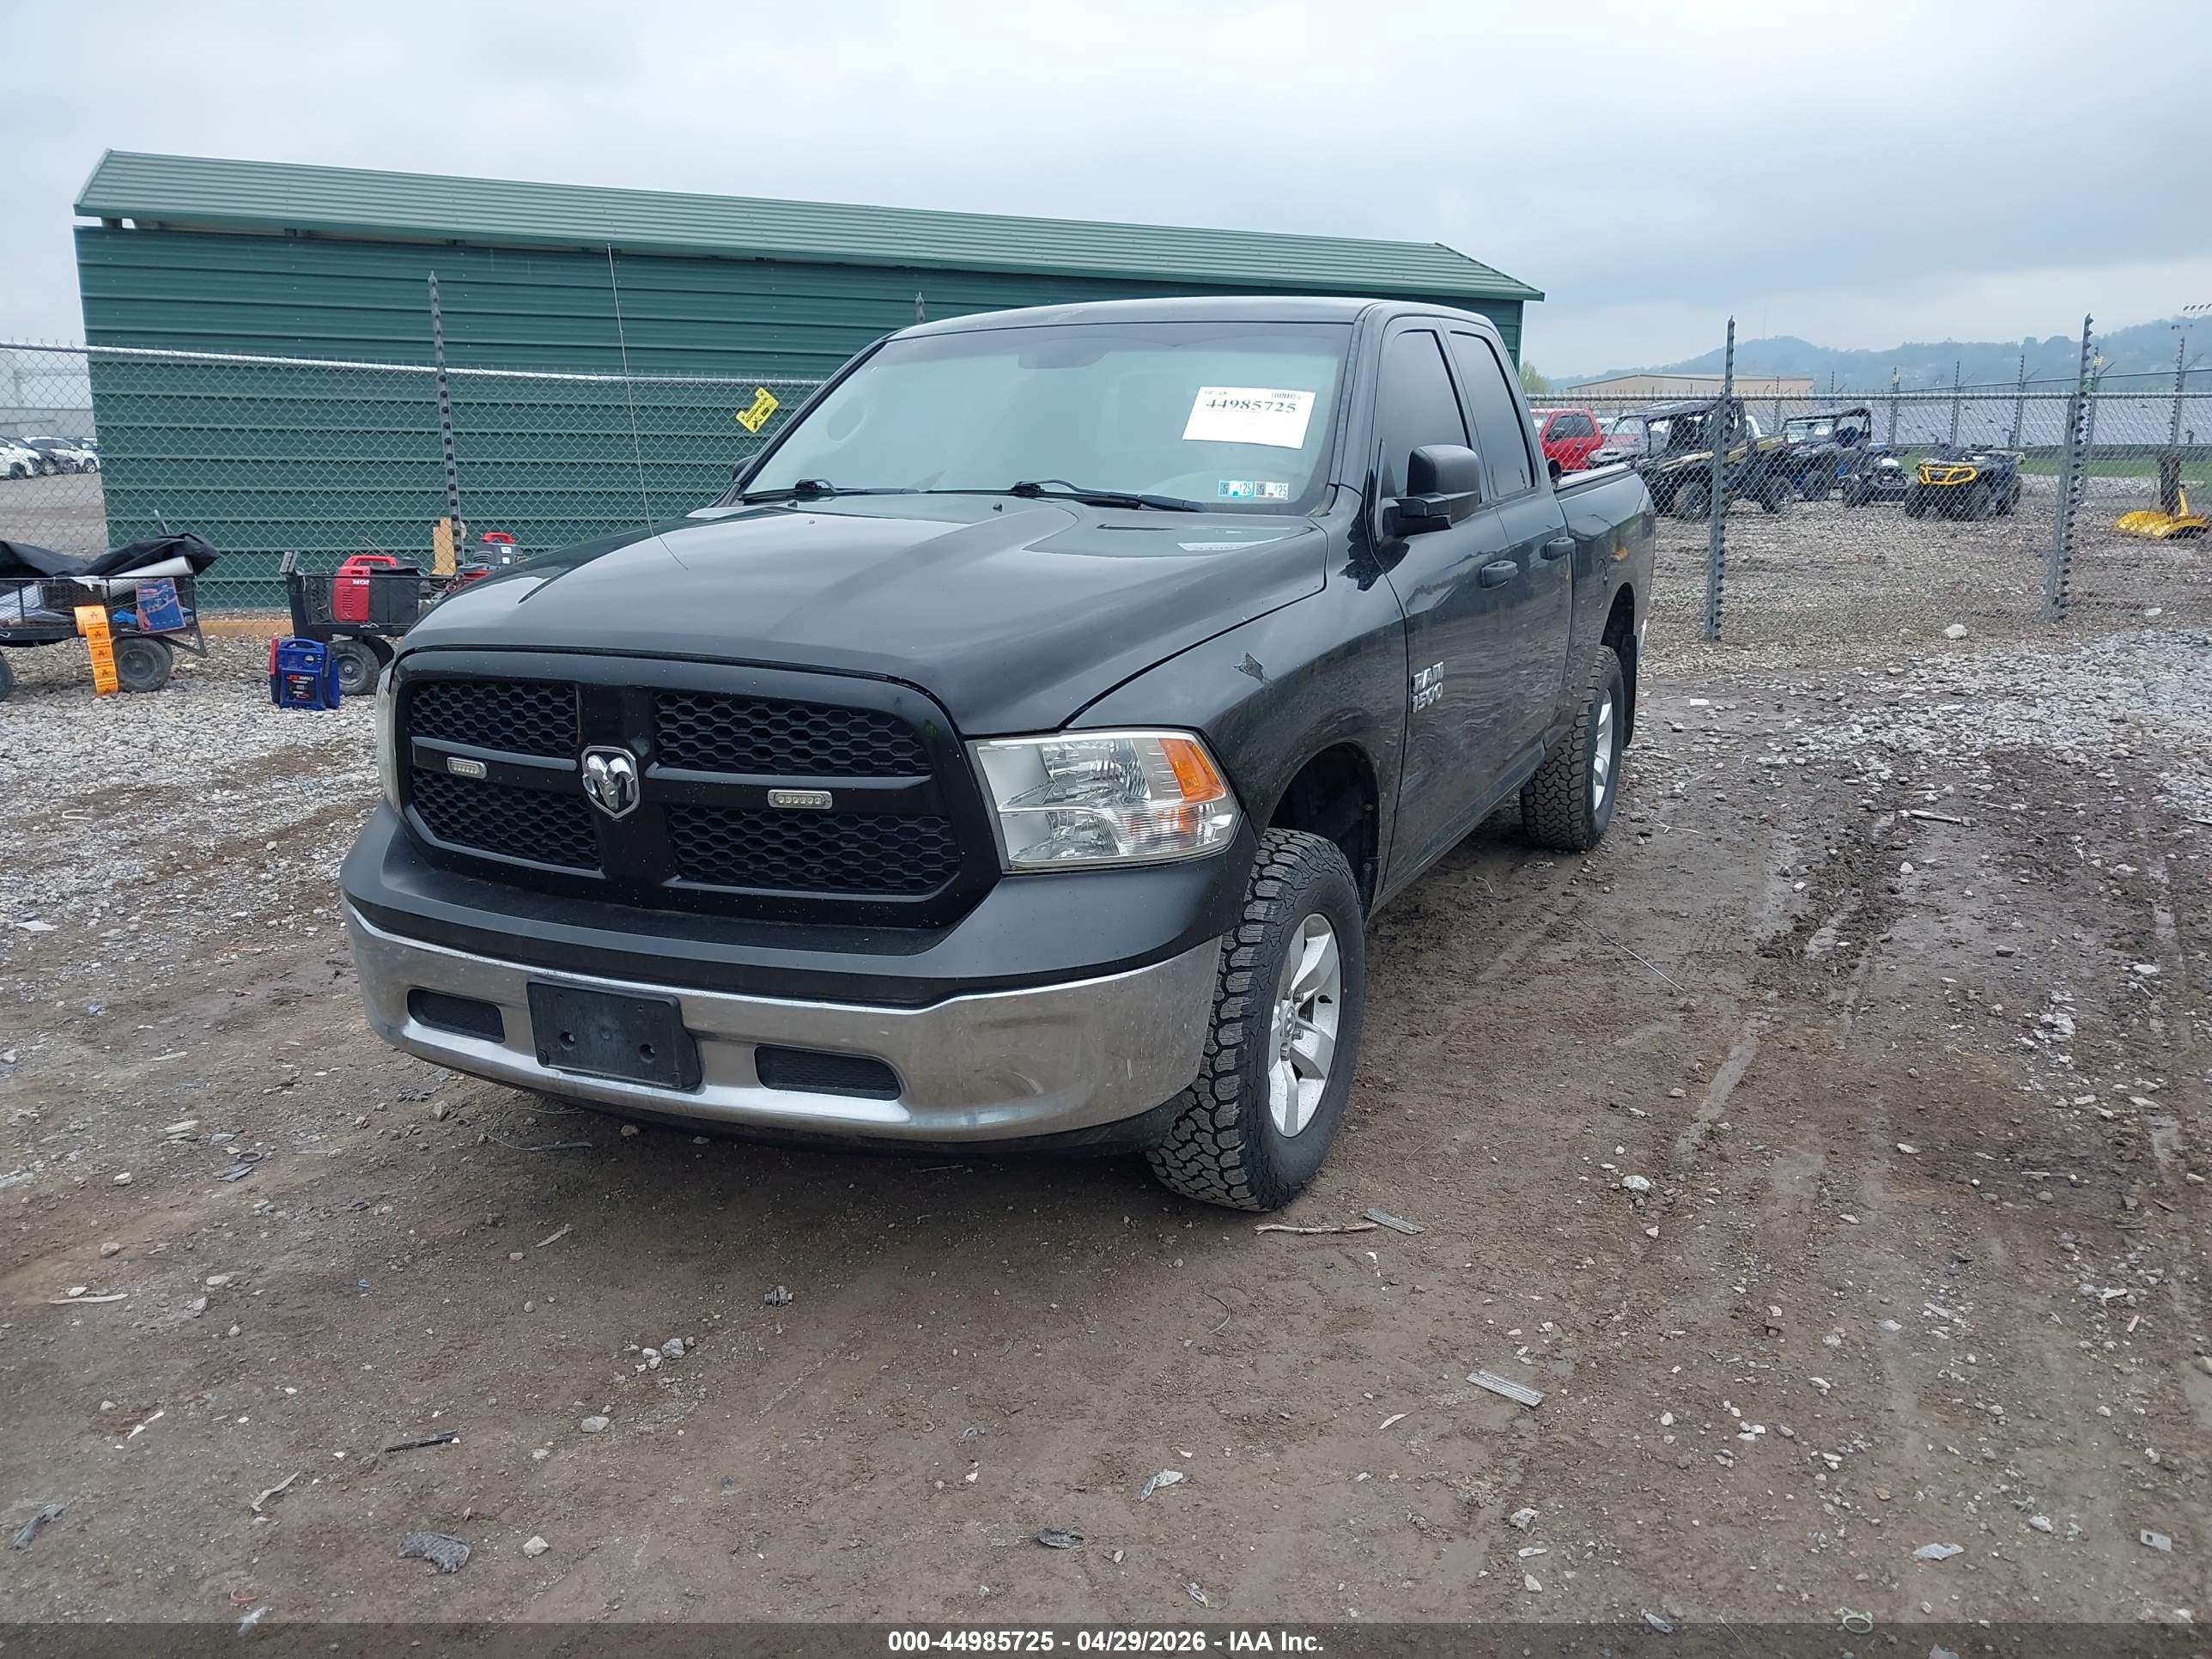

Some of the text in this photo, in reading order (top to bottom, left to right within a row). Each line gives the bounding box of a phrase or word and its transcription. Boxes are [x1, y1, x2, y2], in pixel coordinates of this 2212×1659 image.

[1205, 398, 1297, 414] 44985725
[1413, 660, 1444, 693] RAM
[1412, 682, 1443, 714] 1500
